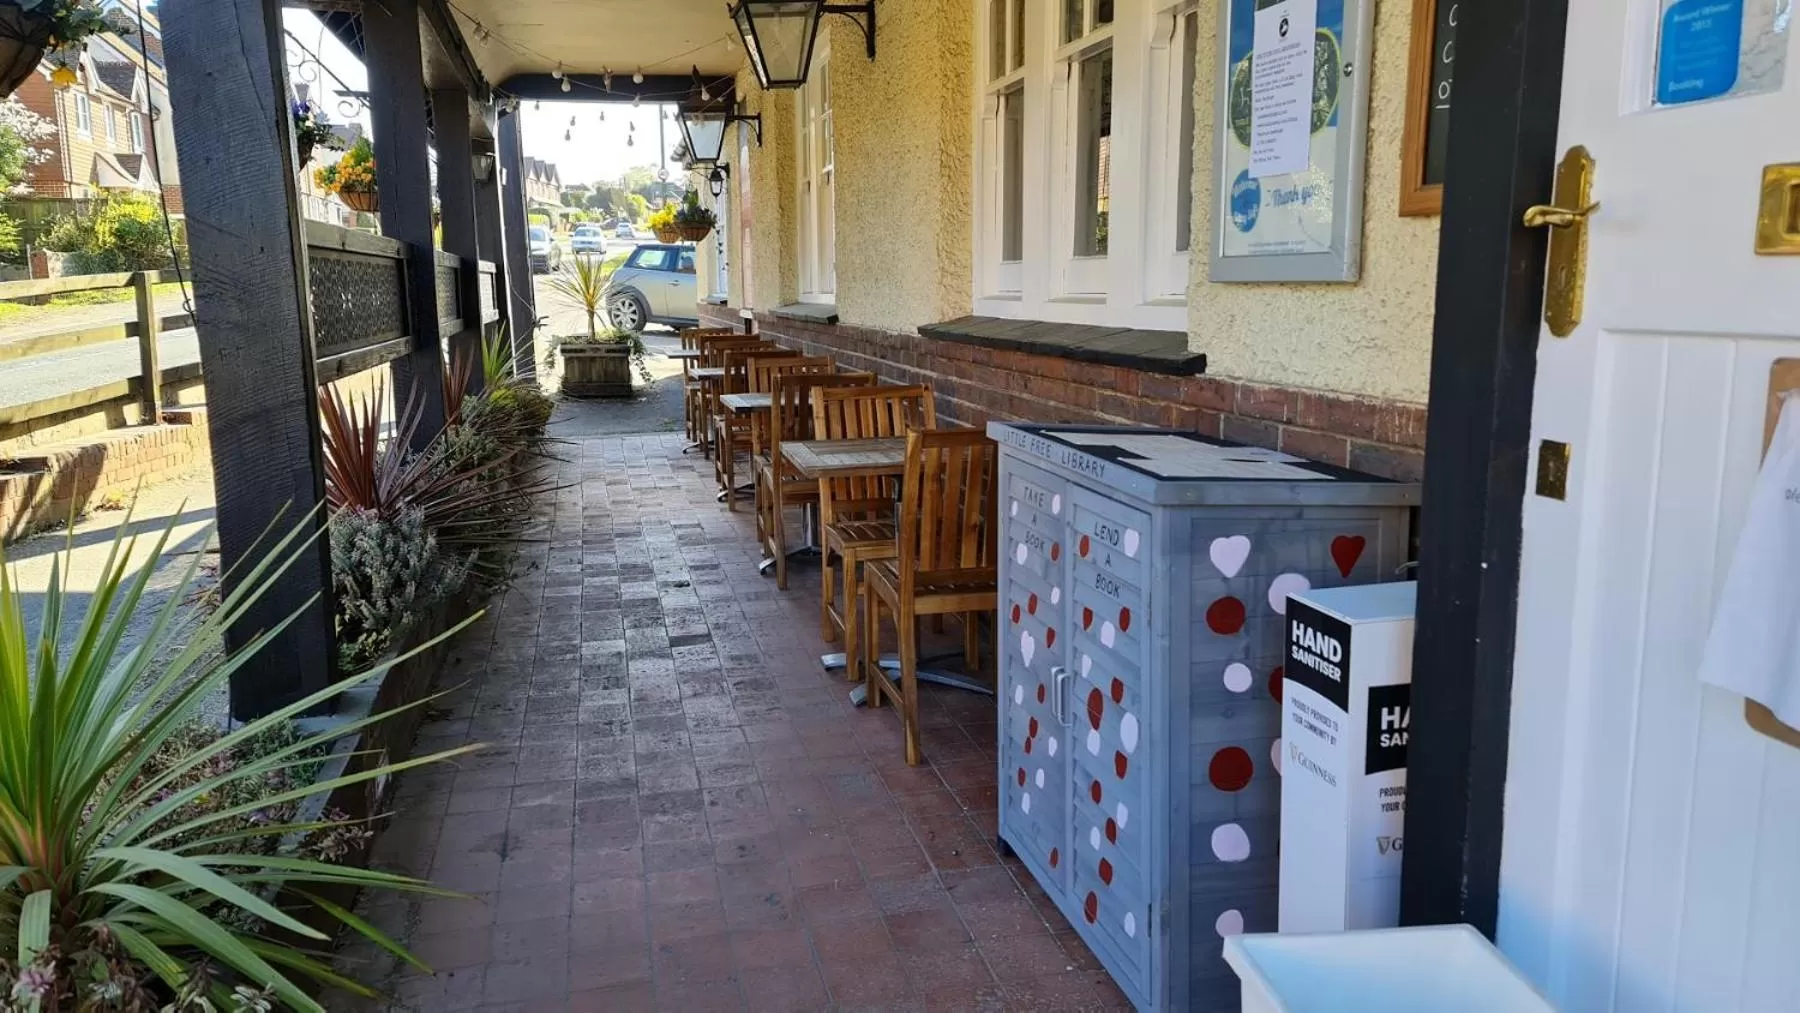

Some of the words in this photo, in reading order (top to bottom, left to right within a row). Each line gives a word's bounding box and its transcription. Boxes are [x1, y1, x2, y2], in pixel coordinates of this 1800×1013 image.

[1272, 184, 1299, 208] Thank
[1003, 429, 1026, 449] LITTLE
[1030, 437, 1052, 459] FREE
[1061, 450, 1106, 479] LIBRARY
[1023, 486, 1045, 508] TAKE
[1031, 513, 1037, 526] A
[1025, 530, 1046, 551] BOOK
[1094, 521, 1120, 547] LEND
[1105, 551, 1112, 567] A
[1095, 573, 1120, 599] BOOK
[1292, 619, 1343, 664] HAND
[1291, 645, 1342, 683] SANITISER
[1303, 719, 1330, 742] COMMUNITY
[1310, 708, 1332, 729] PROVIDED
[1298, 751, 1337, 788] GUINNESS
